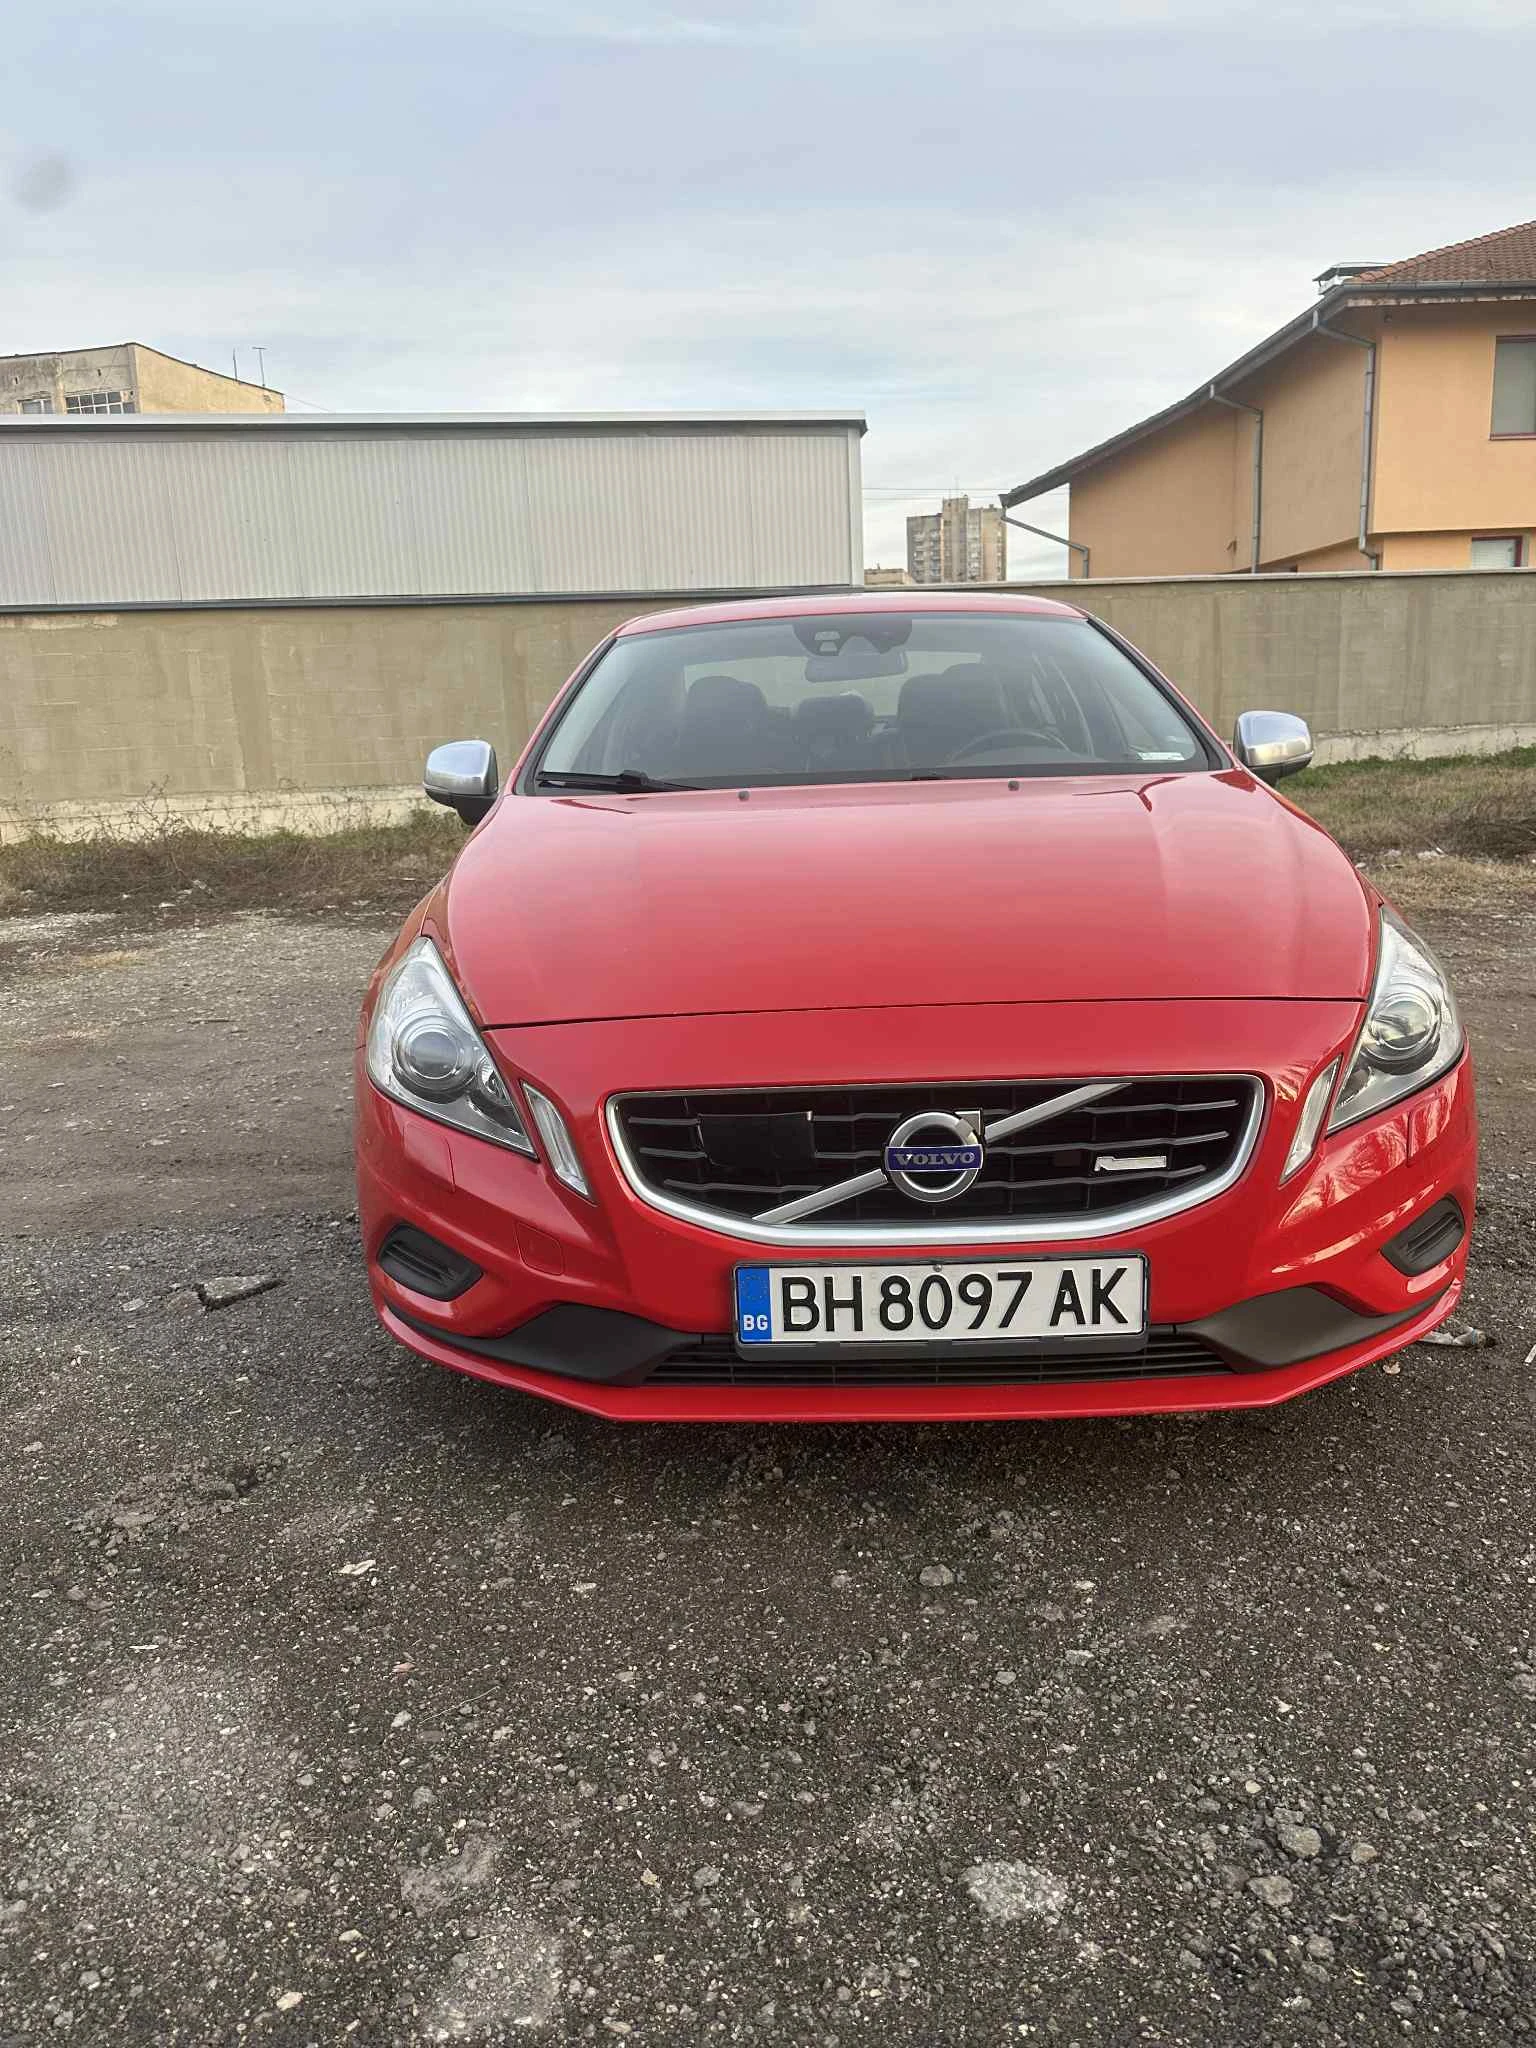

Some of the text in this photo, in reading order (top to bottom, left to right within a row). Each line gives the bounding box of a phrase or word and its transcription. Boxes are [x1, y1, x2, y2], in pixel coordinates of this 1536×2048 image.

[894, 1152, 975, 1165] VOLVO
[781, 1267, 1129, 1332] BH 8097 AK
[742, 1314, 769, 1332] BG
